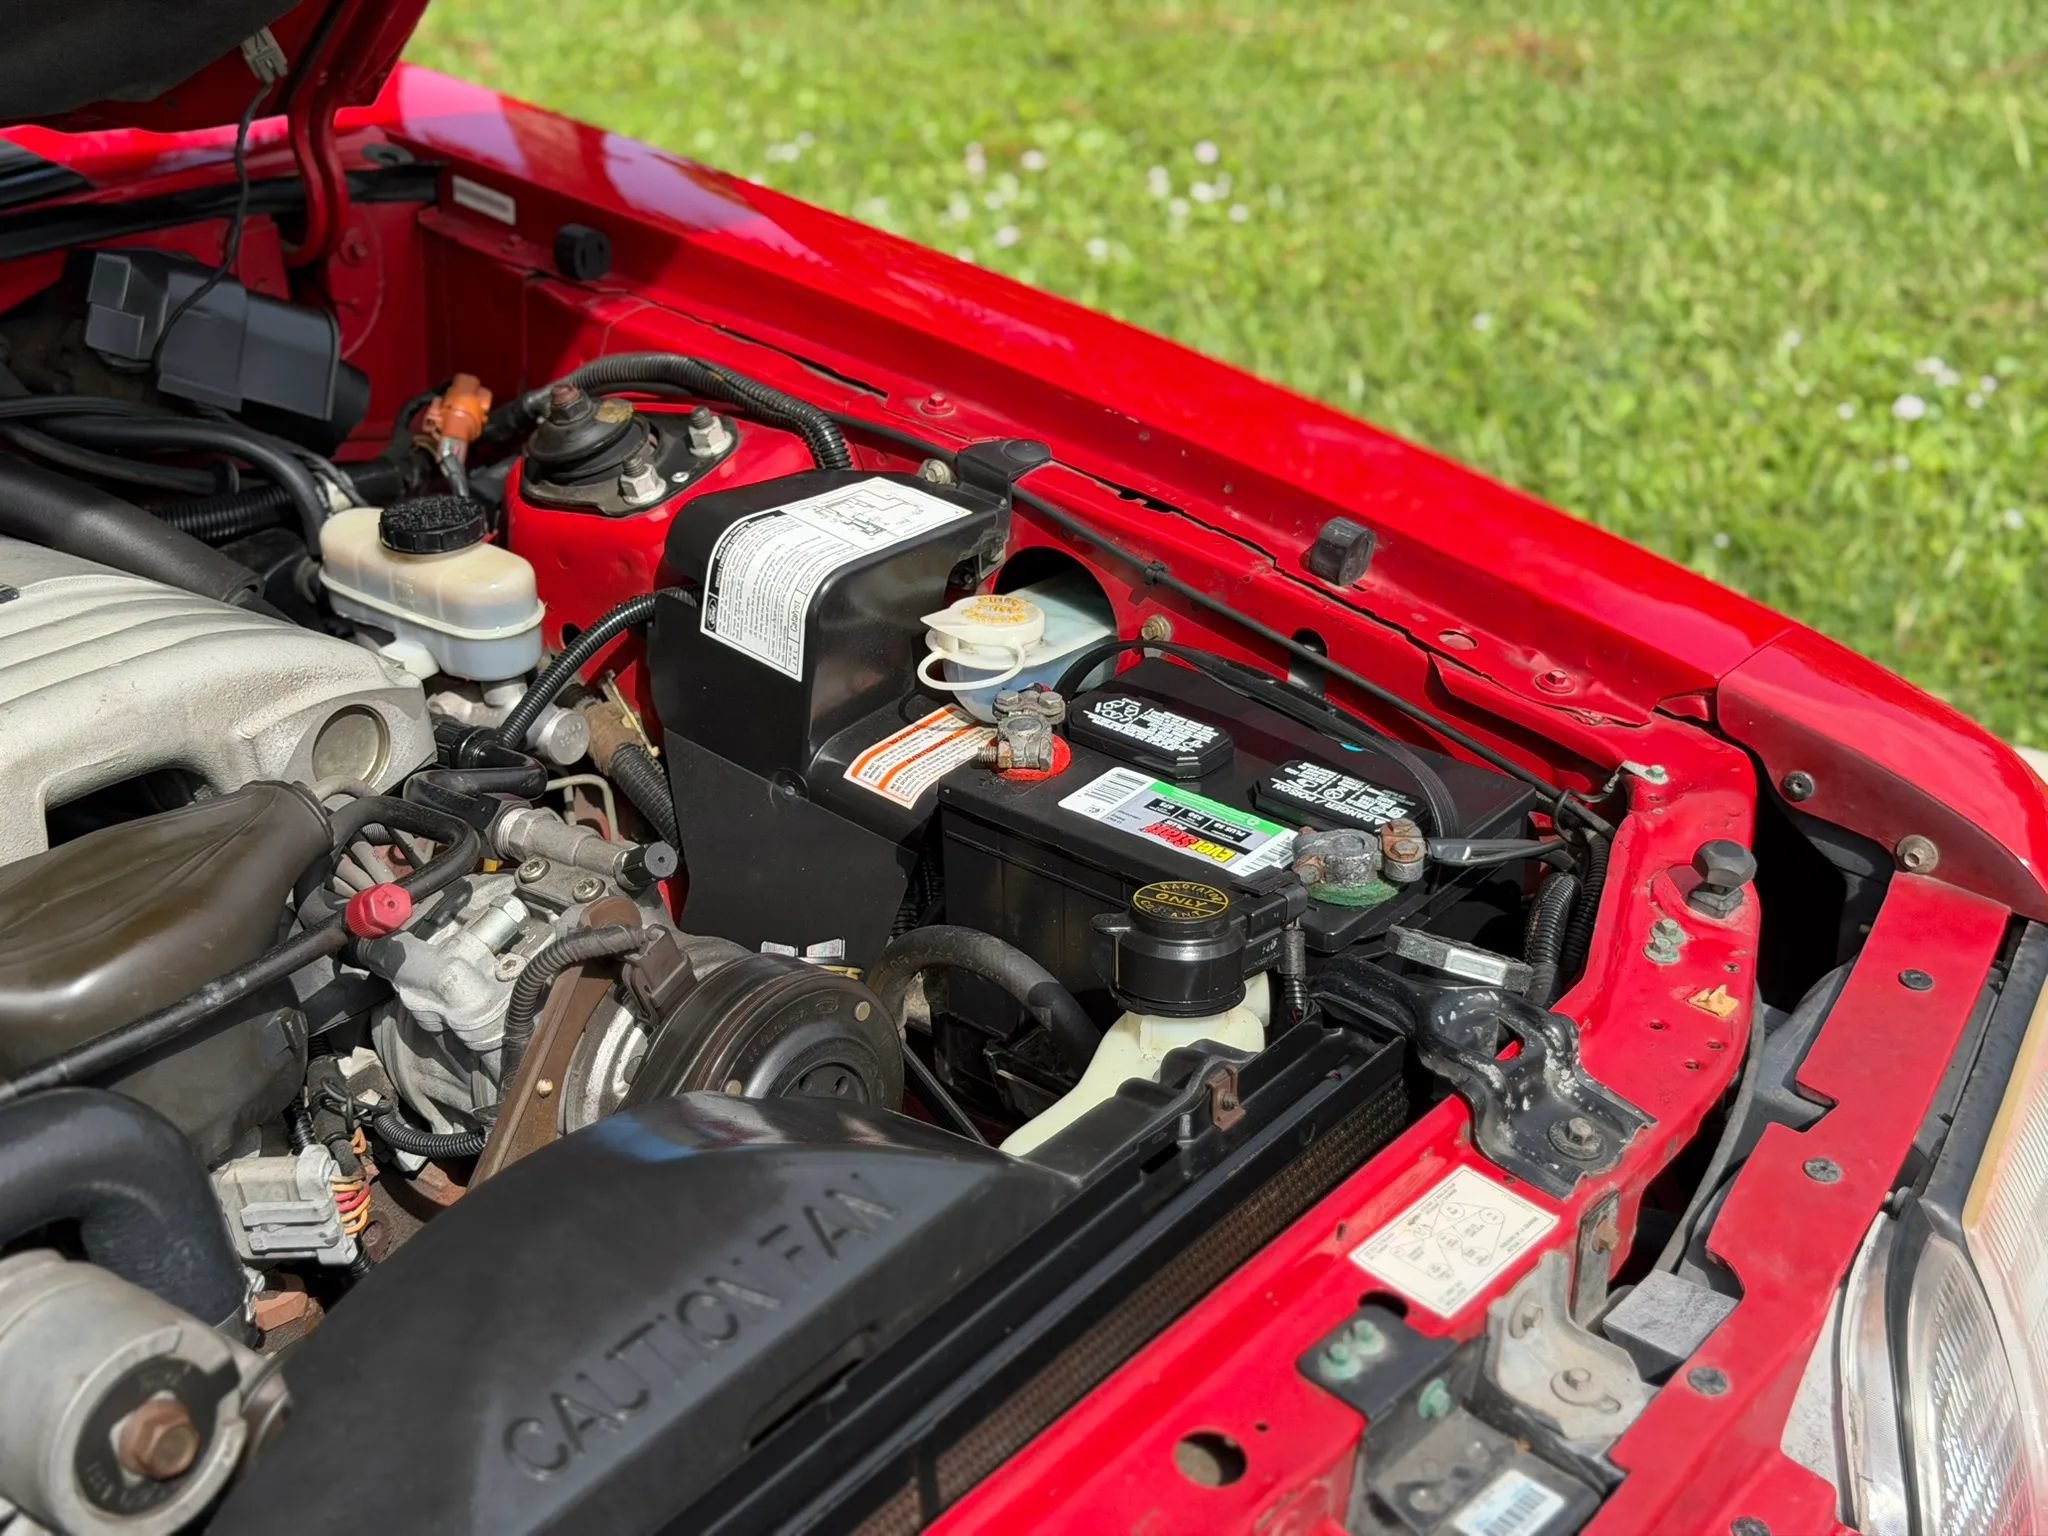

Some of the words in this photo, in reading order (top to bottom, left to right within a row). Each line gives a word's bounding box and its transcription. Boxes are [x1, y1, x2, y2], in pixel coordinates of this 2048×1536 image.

[789, 600, 802, 633] Catalyst
[1271, 782, 1317, 803] POISON
[1323, 800, 1374, 823] DANGER
[1163, 819, 1188, 831] PLUS
[1142, 822, 1237, 863] EverStart
[1155, 892, 1209, 908] ONLY
[1159, 882, 1224, 902] RADIATOR
[504, 1258, 783, 1483] CAUTION
[758, 1171, 898, 1278] FAN
